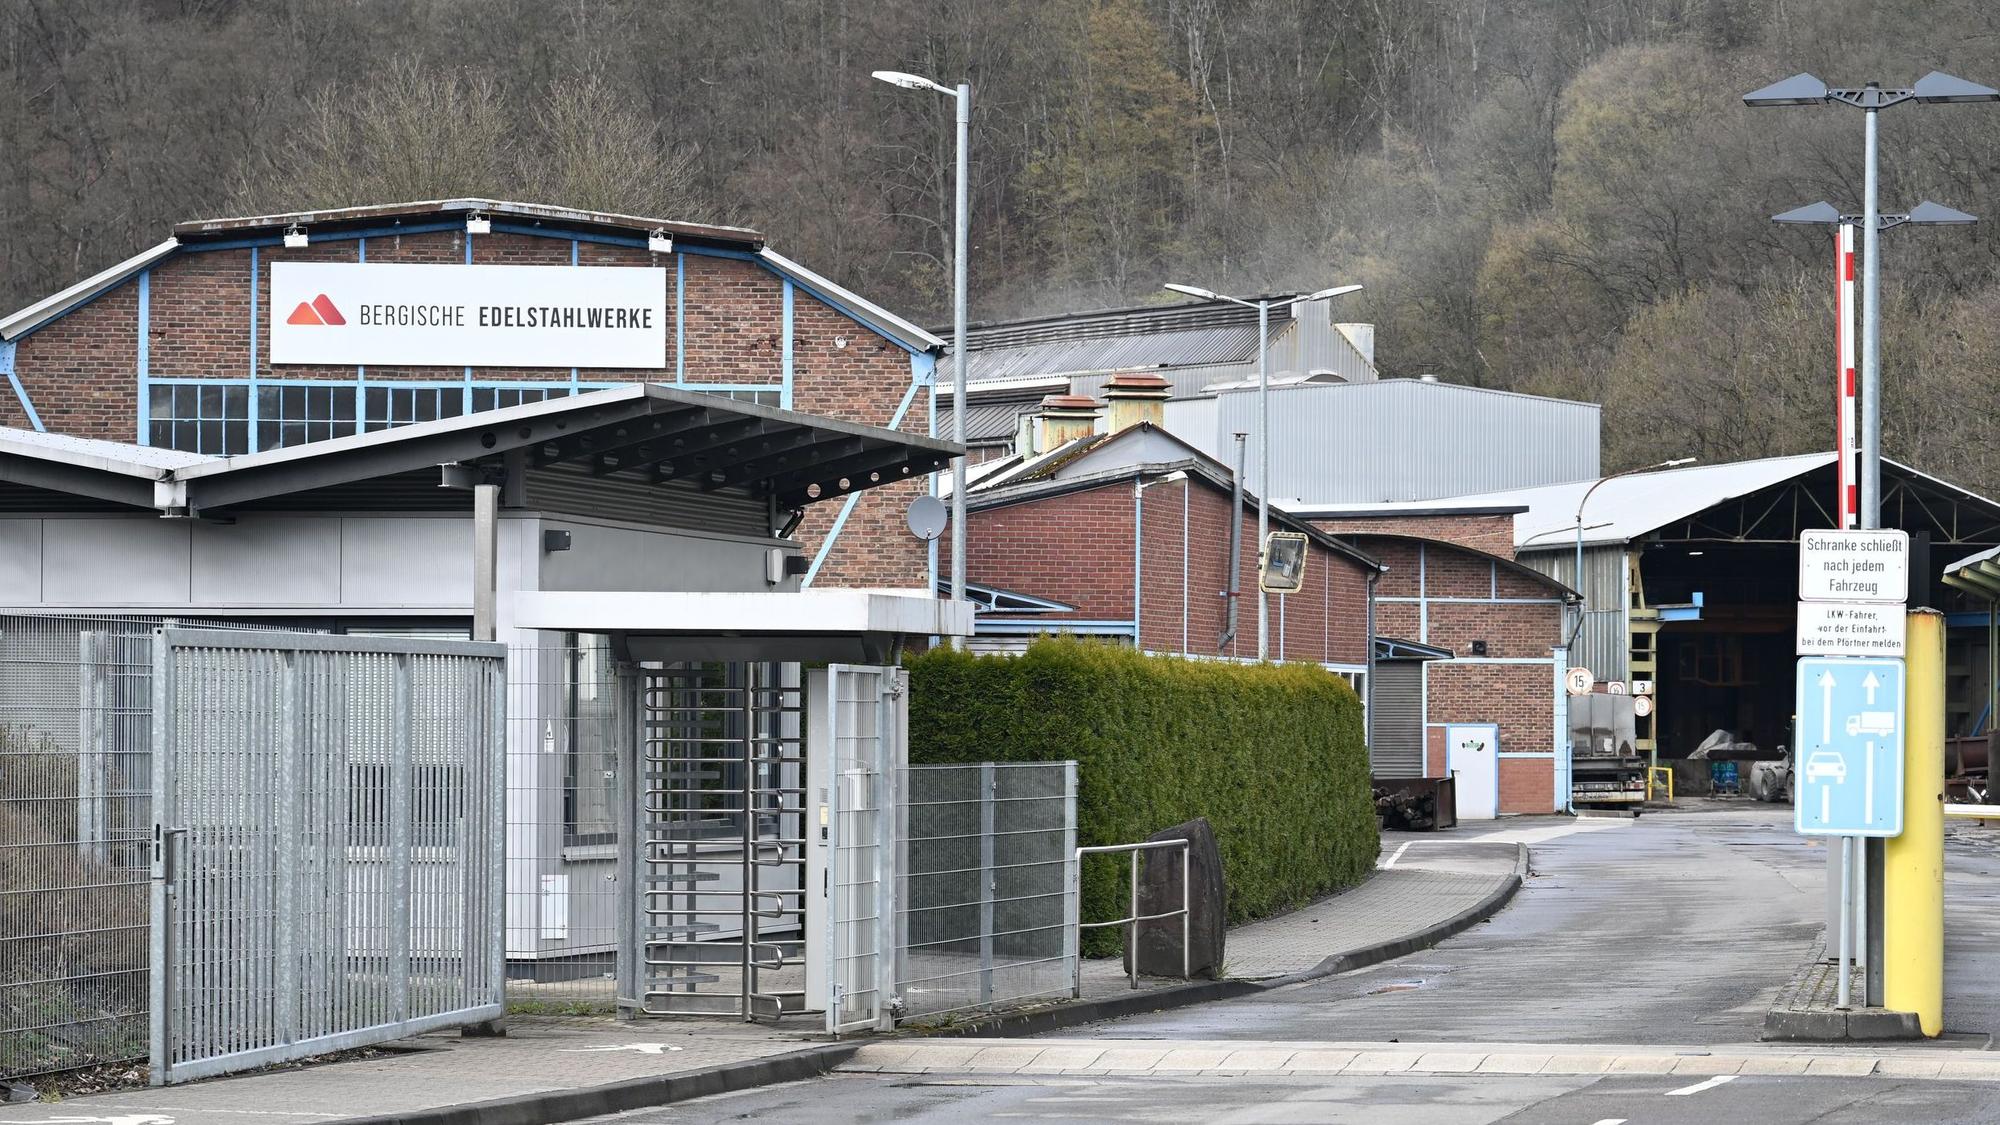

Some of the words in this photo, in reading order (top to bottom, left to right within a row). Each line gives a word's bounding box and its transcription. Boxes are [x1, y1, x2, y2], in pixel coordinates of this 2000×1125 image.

[360, 304, 465, 327] BERGISCHE
[479, 306, 652, 329] EDELSTAHLWERKE
[1807, 538, 1857, 551] Schranke
[1860, 539, 1902, 552] schließt
[1823, 558, 1849, 572] nach
[1851, 559, 1885, 574] jedem
[1829, 578, 1878, 595] Fahrzeug
[1834, 624, 1849, 633] der
[1801, 638, 1815, 646] bei
[1817, 638, 1835, 647] dem
[1837, 638, 1870, 648] Pförtner
[1871, 639, 1901, 648] melden
[1574, 675, 1584, 688] 15
[1639, 682, 1646, 693] 3
